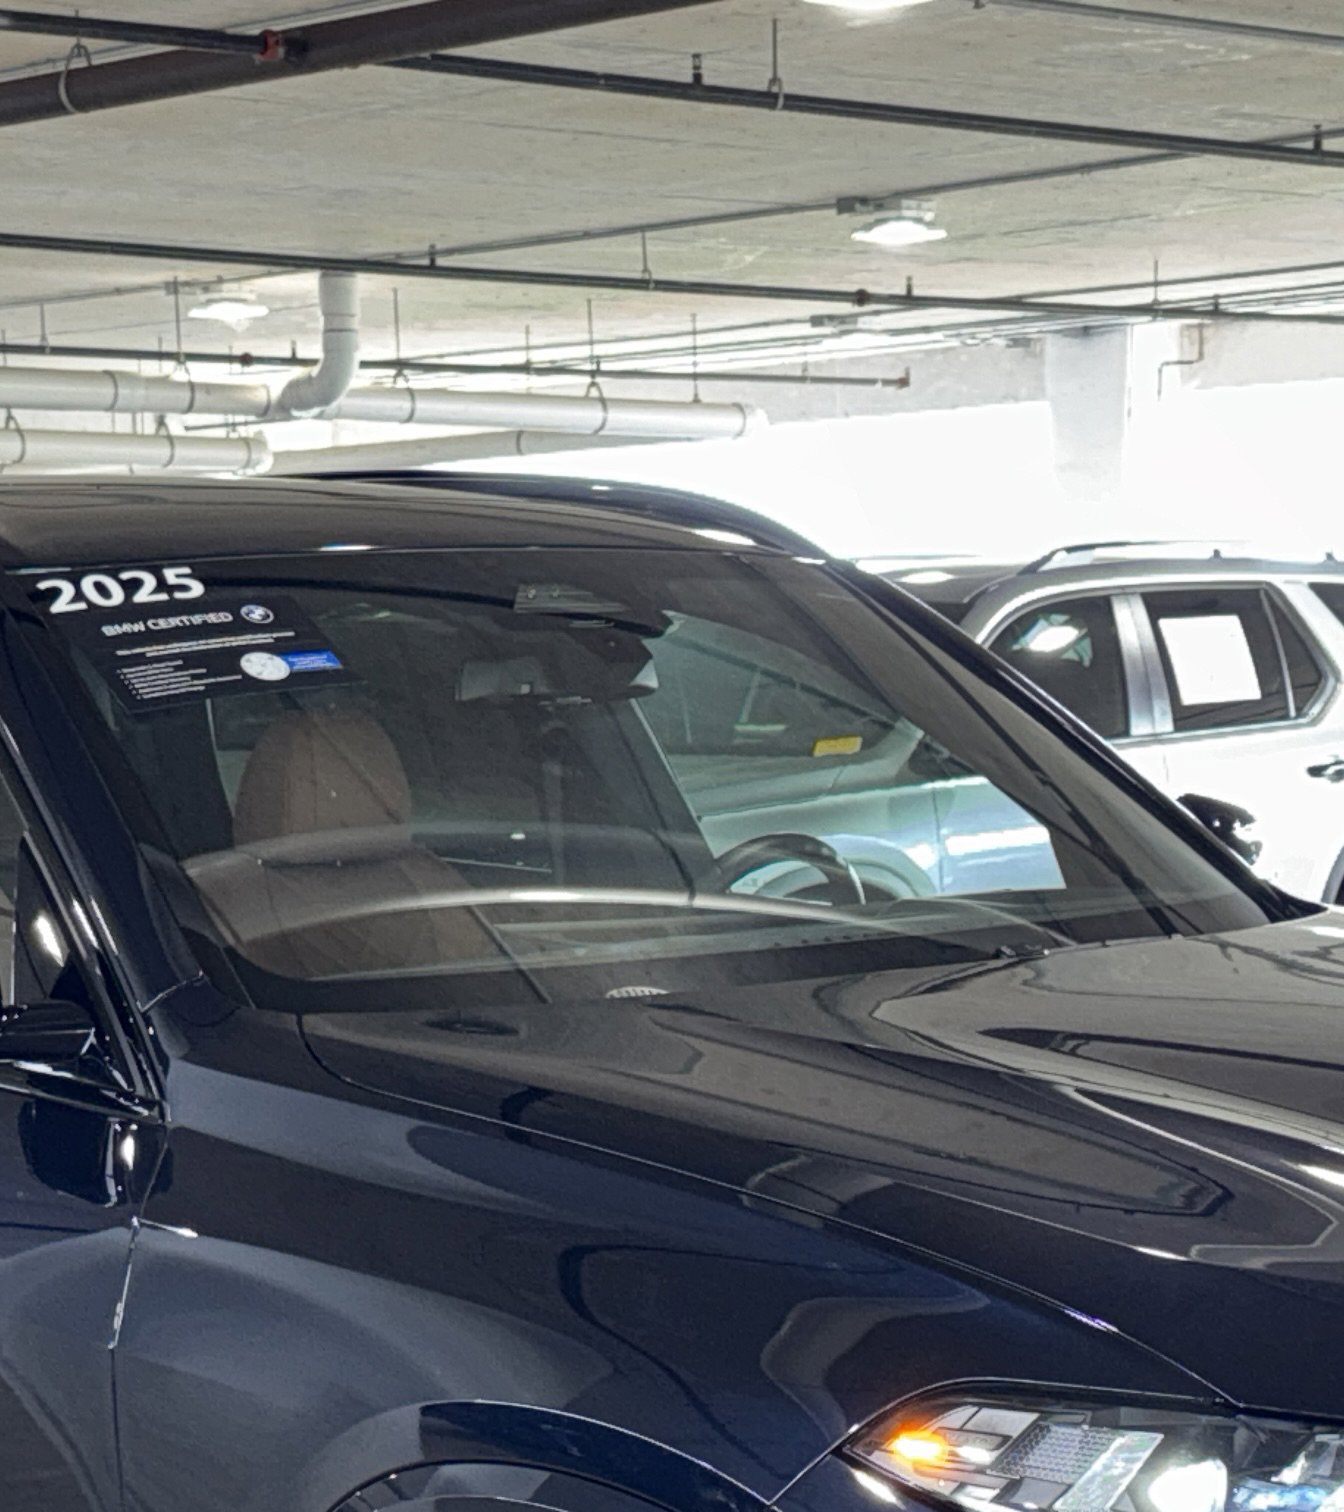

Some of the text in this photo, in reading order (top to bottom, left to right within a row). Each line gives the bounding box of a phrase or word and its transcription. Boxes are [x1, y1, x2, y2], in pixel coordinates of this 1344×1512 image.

[36, 566, 205, 614] 2025
[101, 612, 233, 637] BMW CERTIFIED
